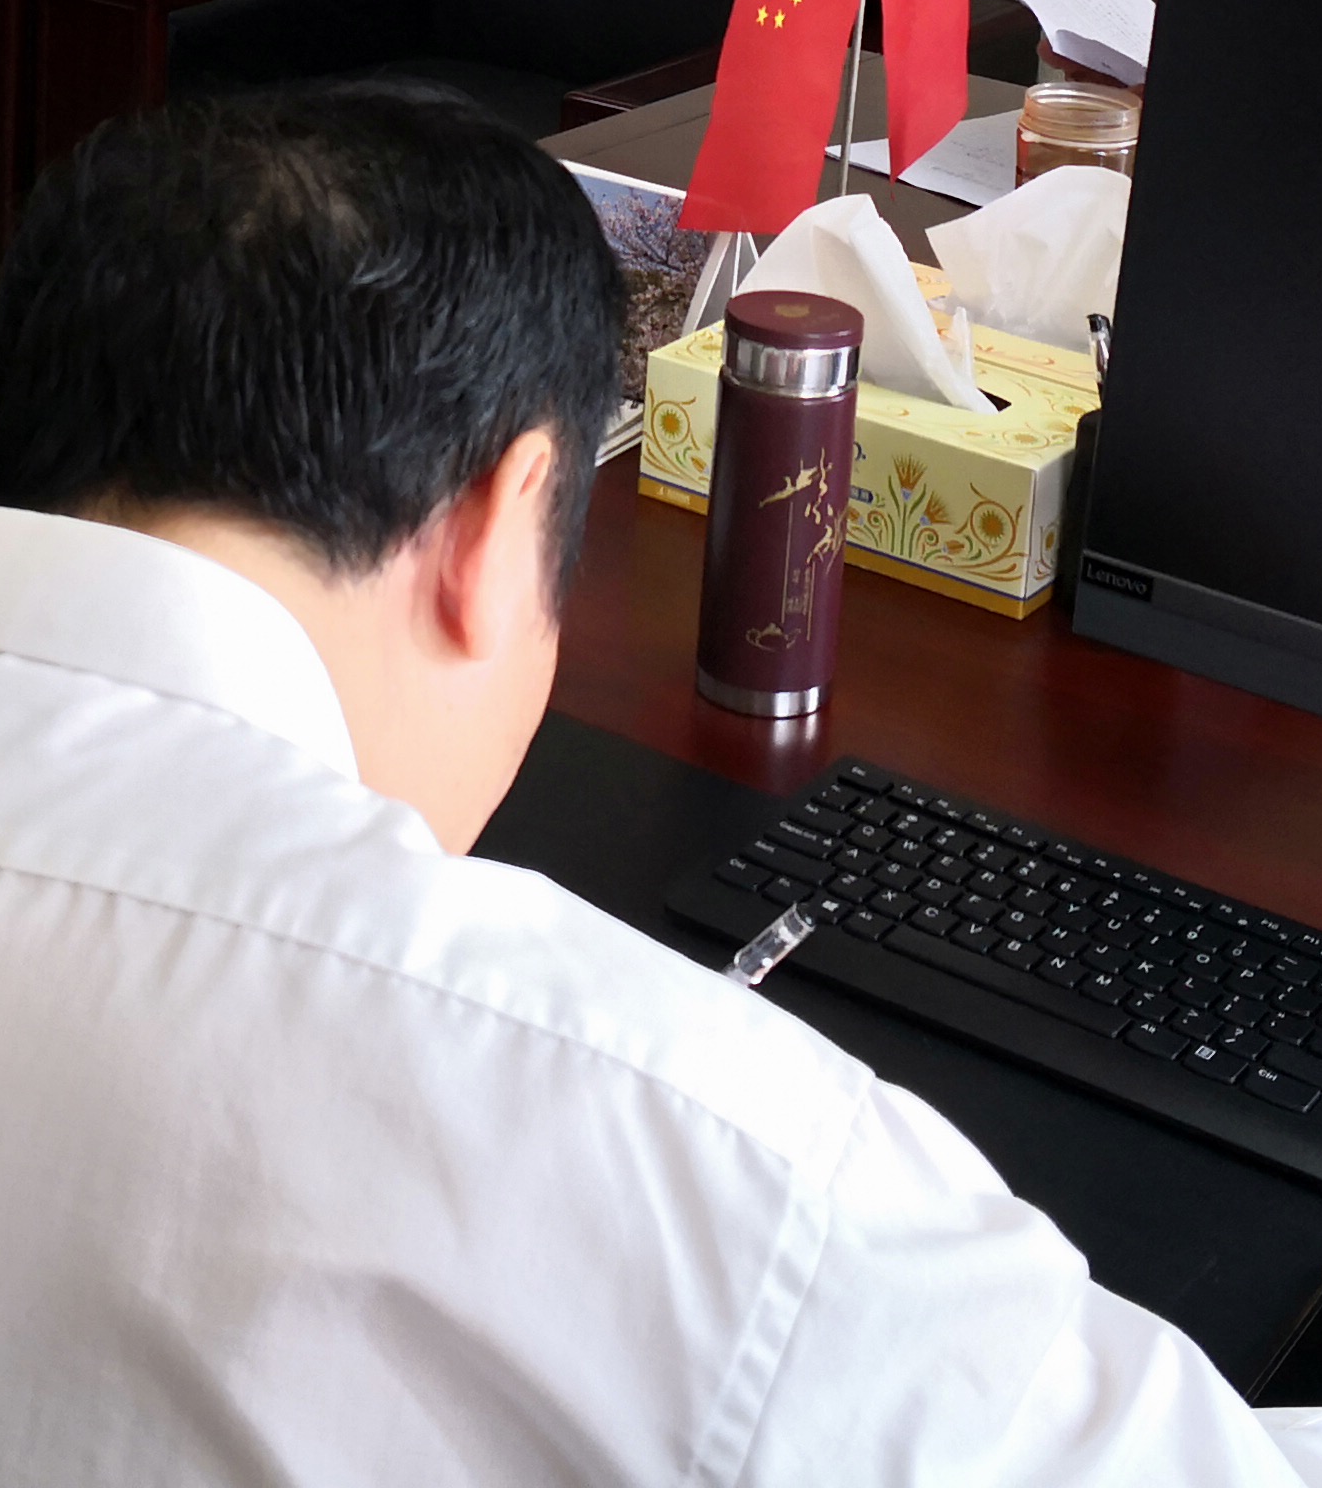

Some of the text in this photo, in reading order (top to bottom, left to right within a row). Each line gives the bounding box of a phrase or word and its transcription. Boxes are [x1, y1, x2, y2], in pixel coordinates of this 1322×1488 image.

[1087, 564, 1147, 595] Lenovo
[847, 849, 858, 858] A
[881, 891, 897, 901] X
[926, 907, 939, 917] C
[1069, 903, 1080, 912] Y
[970, 924, 983, 934] V
[1108, 919, 1121, 930] U
[1052, 927, 1067, 939] H
[1187, 931, 1198, 939] 9
[1096, 945, 1108, 954] J
[1051, 957, 1066, 968] N
[1196, 954, 1210, 963] O
[1138, 961, 1154, 973] K
[1240, 969, 1254, 978] P
[1096, 975, 1112, 987] M
[1185, 977, 1194, 988] L
[1258, 1069, 1277, 1081] Ctrl
